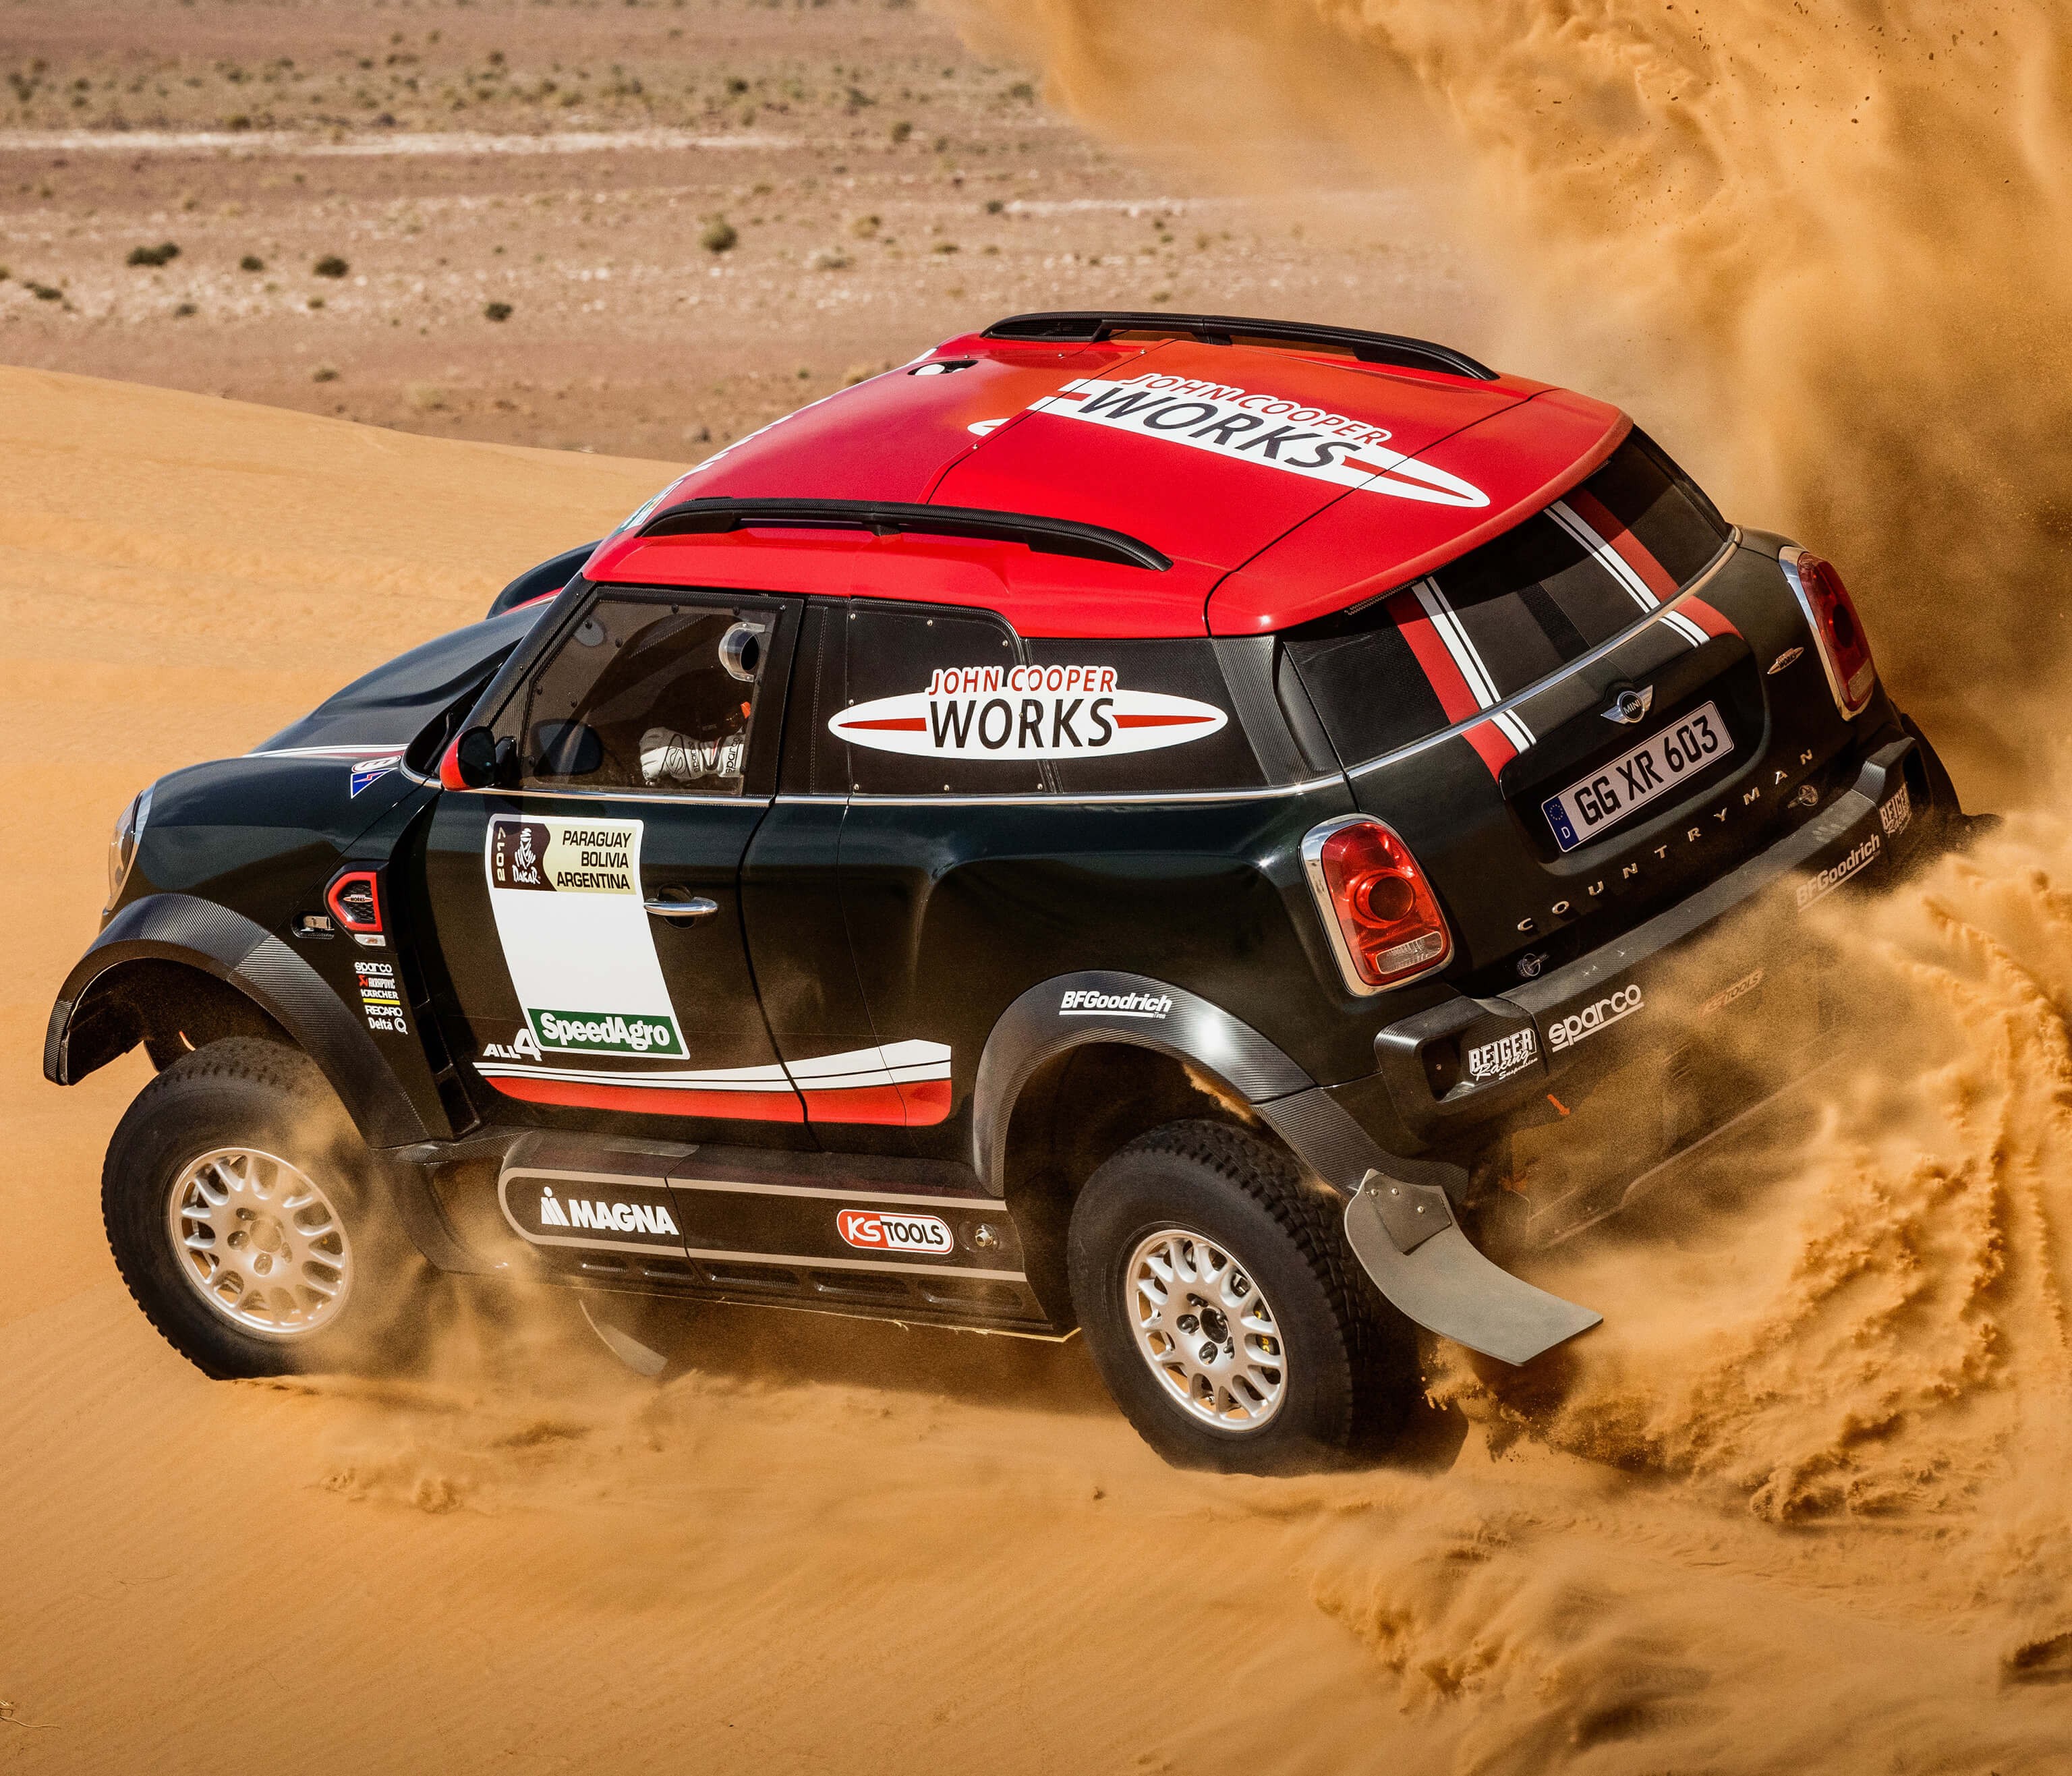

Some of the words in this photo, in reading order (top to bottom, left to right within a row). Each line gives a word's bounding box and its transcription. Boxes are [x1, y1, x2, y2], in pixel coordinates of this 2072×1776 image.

[1122, 374, 1239, 402] JOHN
[1239, 397, 1388, 445] COOPER
[1078, 387, 1362, 468] WORKS
[928, 670, 1000, 695] JOHN
[1012, 668, 1115, 693] COOPER
[929, 698, 1114, 749] WORKS
[1623, 699, 1642, 715] MINI
[726, 737, 741, 774] sparco
[1574, 776, 1621, 827] GG
[1617, 749, 1665, 801] XR
[1664, 714, 1719, 774] 603
[562, 830, 632, 848] PARAGUAY
[1516, 747, 1813, 933] COUNTRYMAN
[1560, 826, 1571, 840] D
[496, 826, 507, 882] 2017
[581, 851, 629, 869] BOLIVIA
[1795, 834, 1880, 907] BFGoodrich
[511, 865, 541, 885] DAKAR
[556, 872, 631, 890] ARGENTINA
[354, 962, 393, 973] sparco
[364, 1005, 403, 1017] RECARO
[1060, 990, 1173, 1012] BFGoodrich
[1548, 984, 1642, 1046] sparco
[540, 1012, 670, 1051] SpeedAgro
[1469, 1028, 1534, 1072] BEIGER
[1474, 1050, 1529, 1081] Racing
[569, 1199, 680, 1236] MAGNA
[846, 1216, 883, 1242] KS
[880, 1217, 944, 1246] TOOLS
